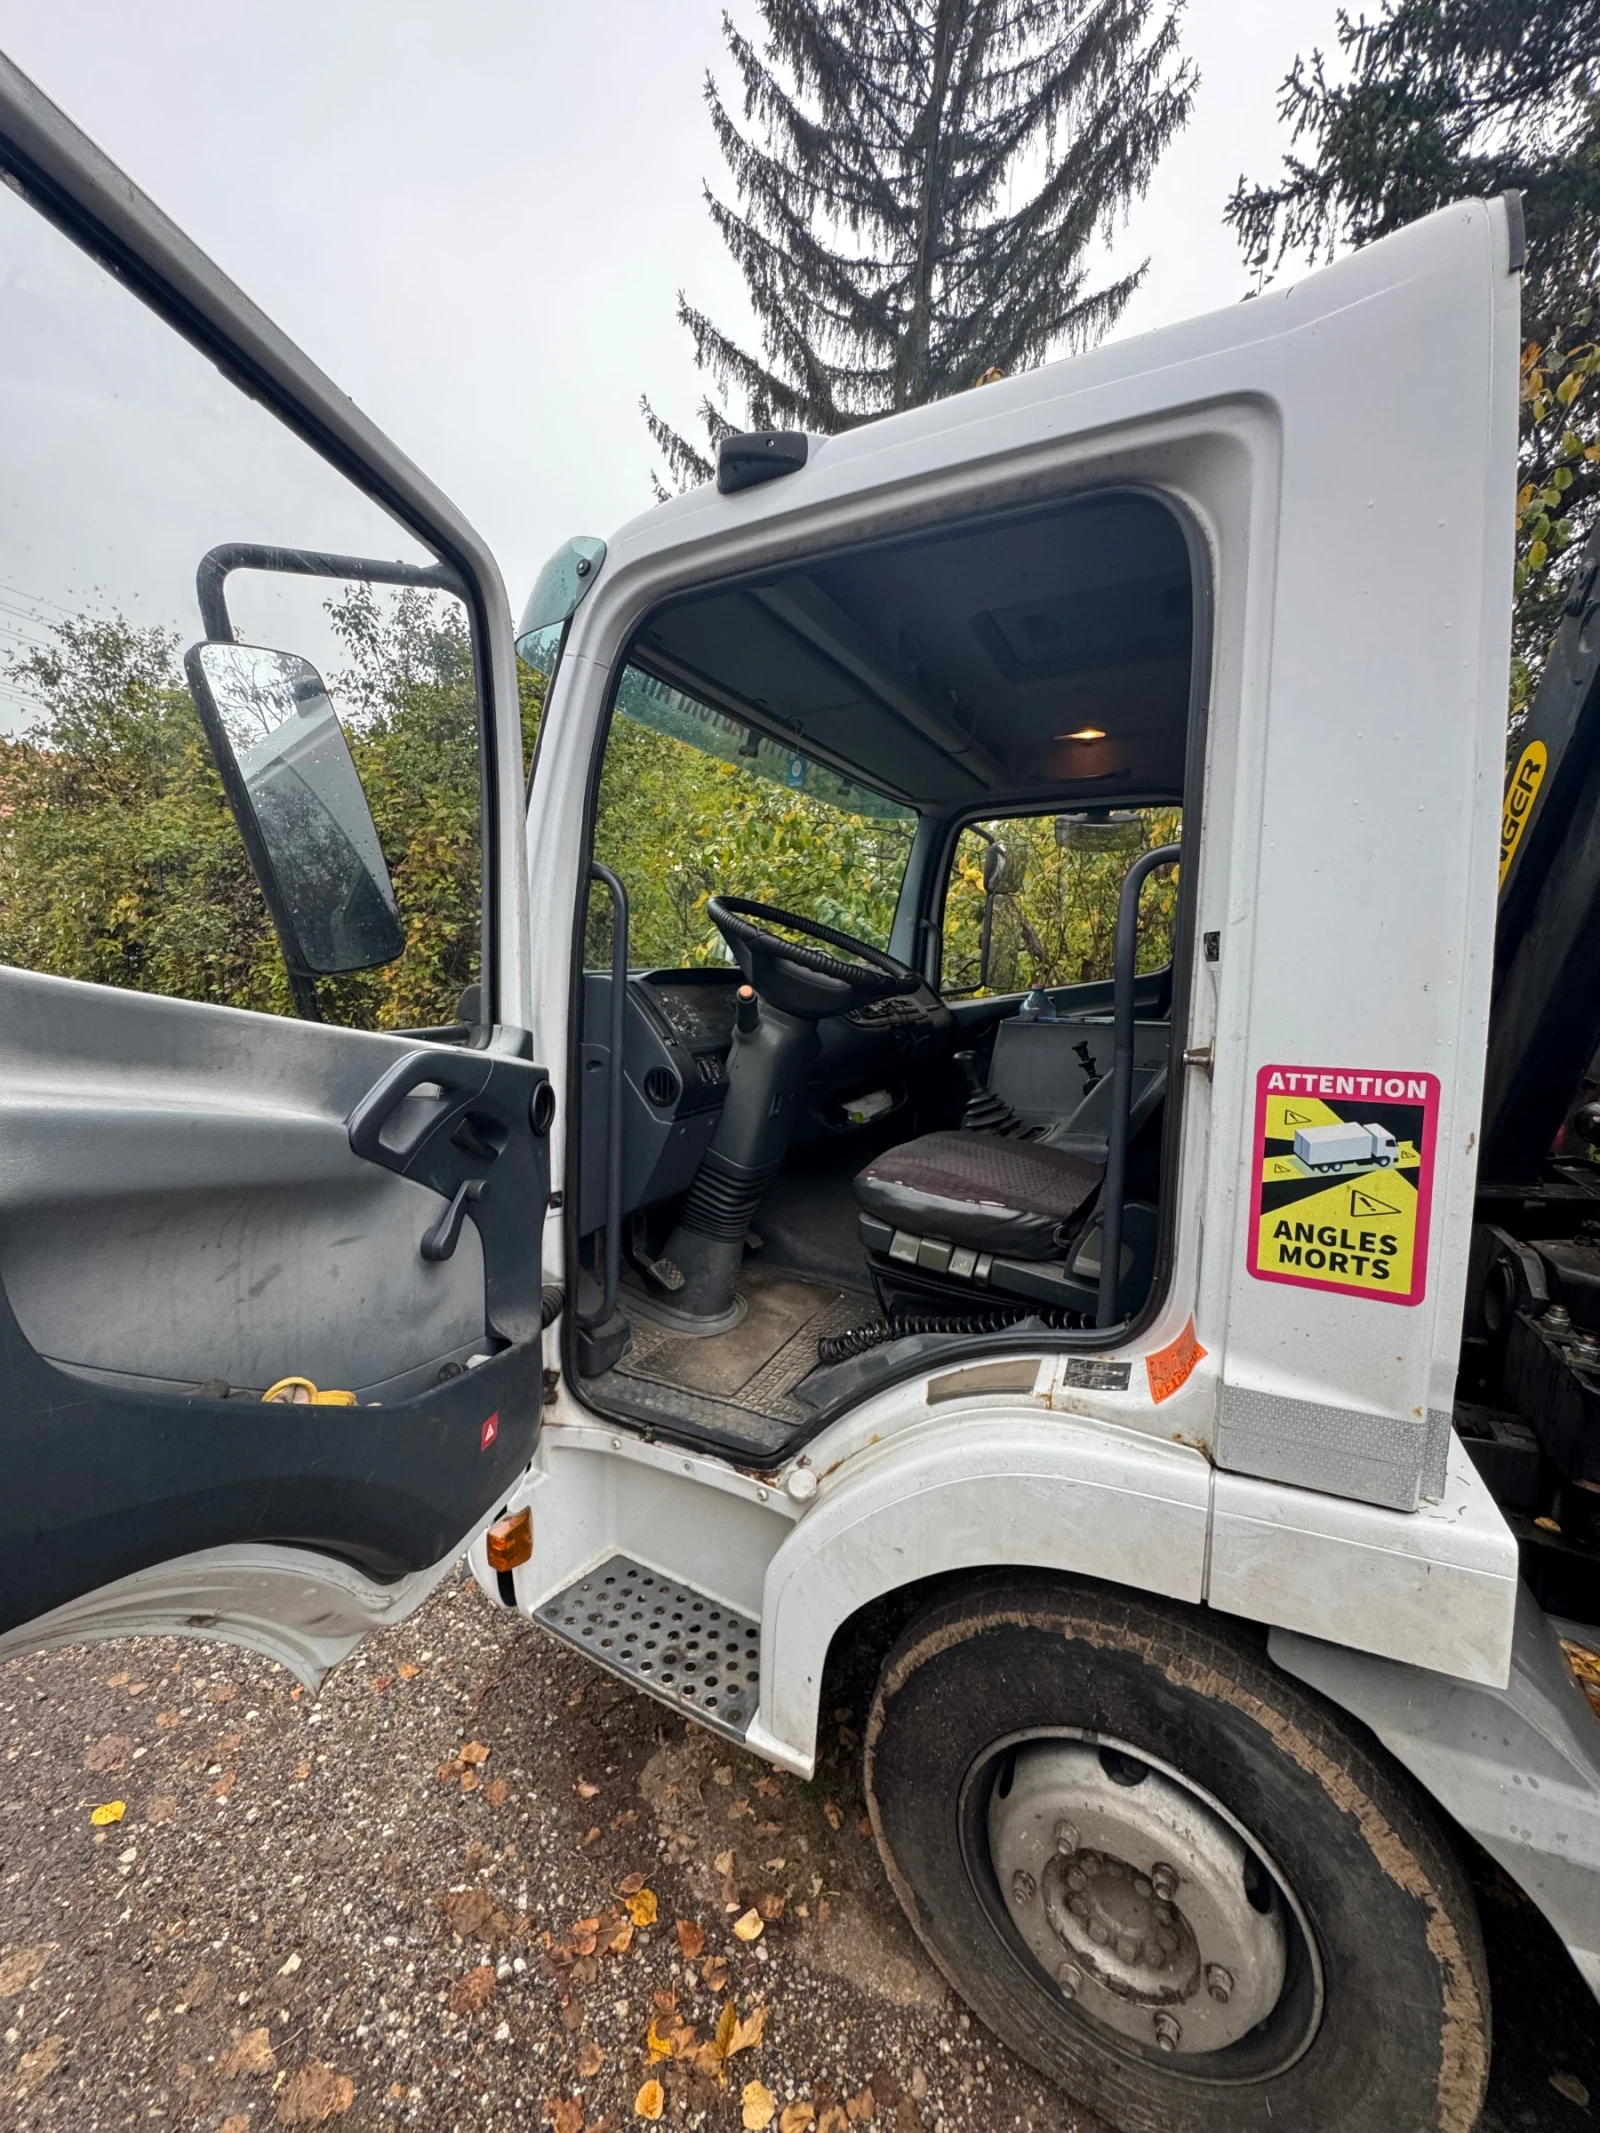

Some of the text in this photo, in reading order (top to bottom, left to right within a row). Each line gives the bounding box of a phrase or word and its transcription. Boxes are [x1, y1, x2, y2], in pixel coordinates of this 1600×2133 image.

[1267, 1072, 1427, 1099] ATTENTION
[1273, 1220, 1398, 1256] ANGLES
[1279, 1244, 1390, 1280] MORTS
